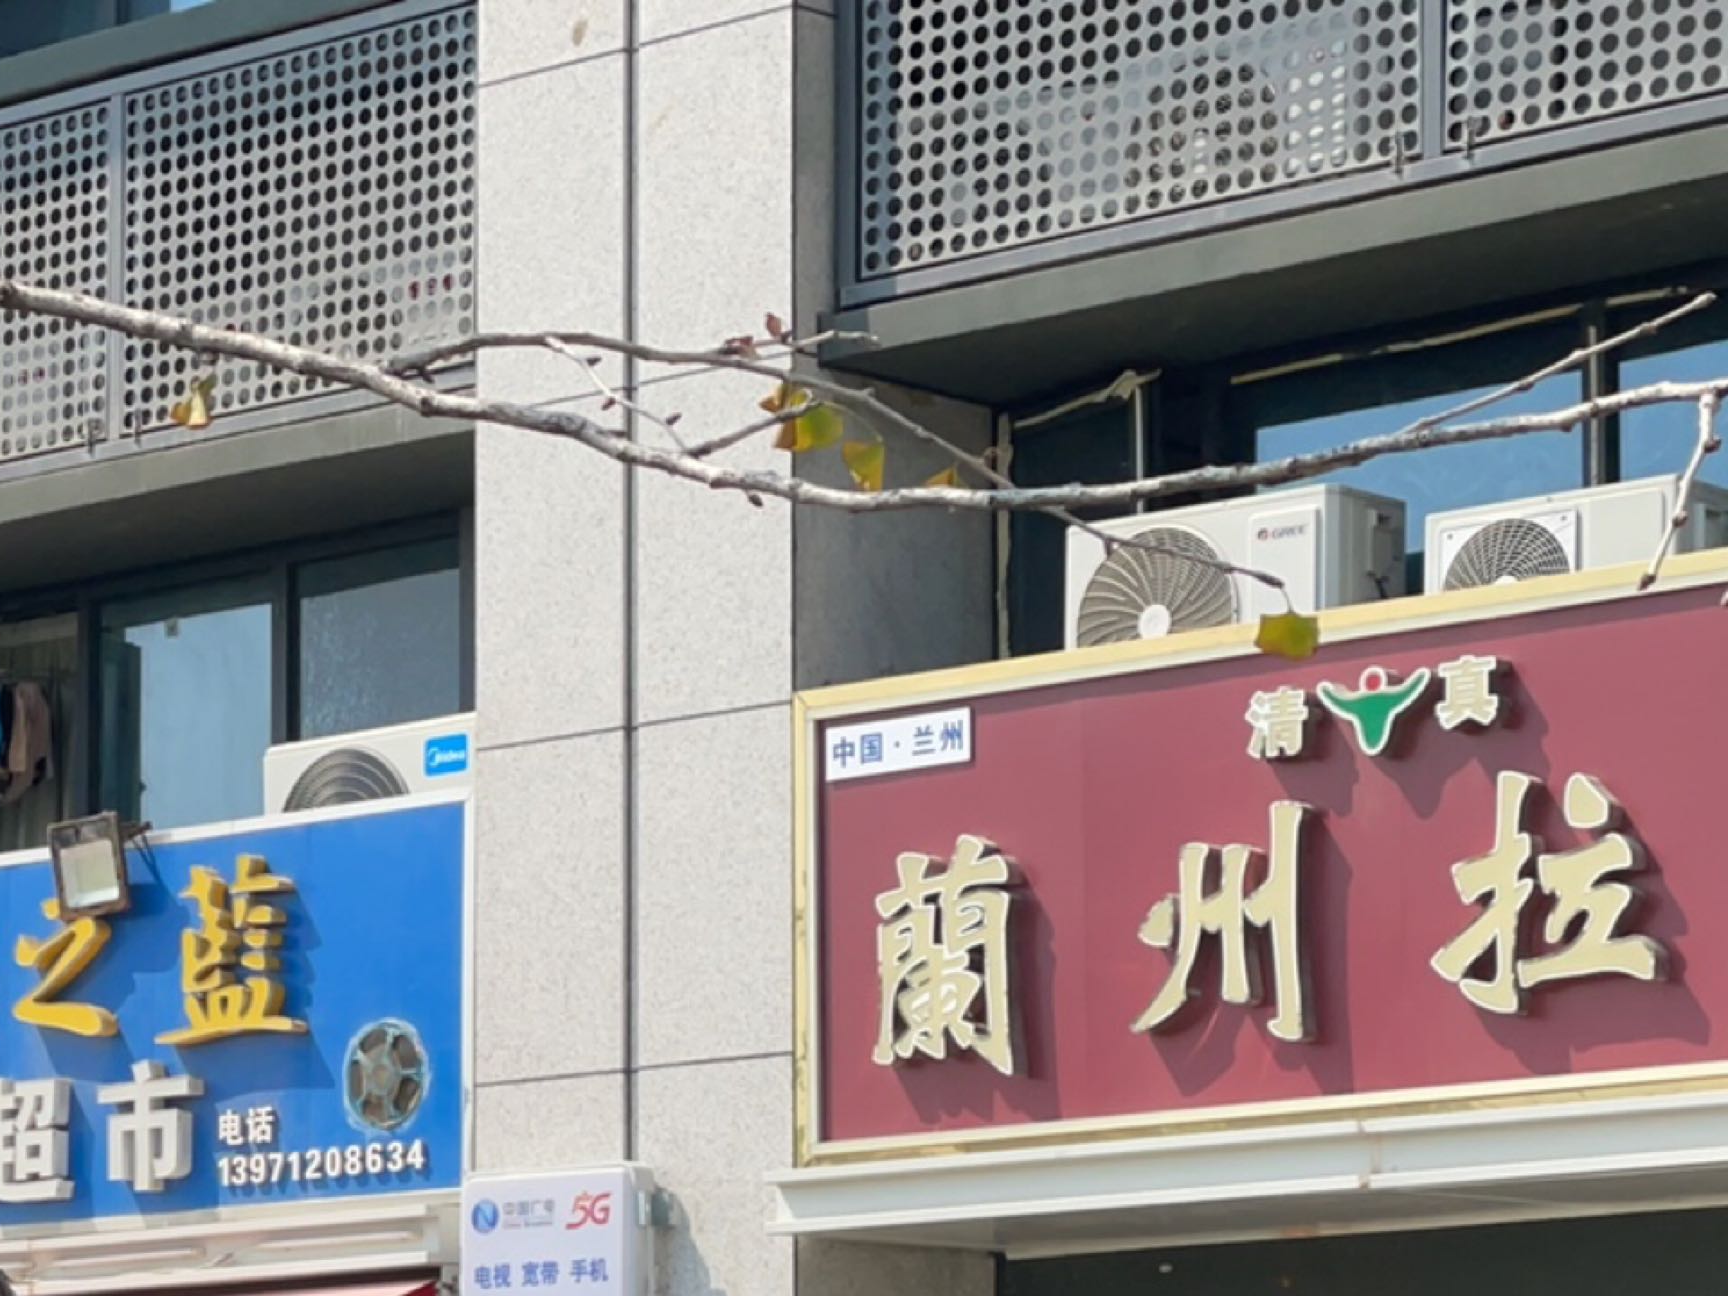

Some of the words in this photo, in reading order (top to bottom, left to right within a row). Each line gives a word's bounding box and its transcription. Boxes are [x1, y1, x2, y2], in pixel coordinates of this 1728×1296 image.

[218, 1107, 275, 1145] 电话
[218, 1139, 425, 1186] 13971208634
[565, 1192, 612, 1230] 5G
[474, 1264, 511, 1289] 电视
[521, 1261, 559, 1287] 宽带
[569, 1258, 609, 1283] 手机
